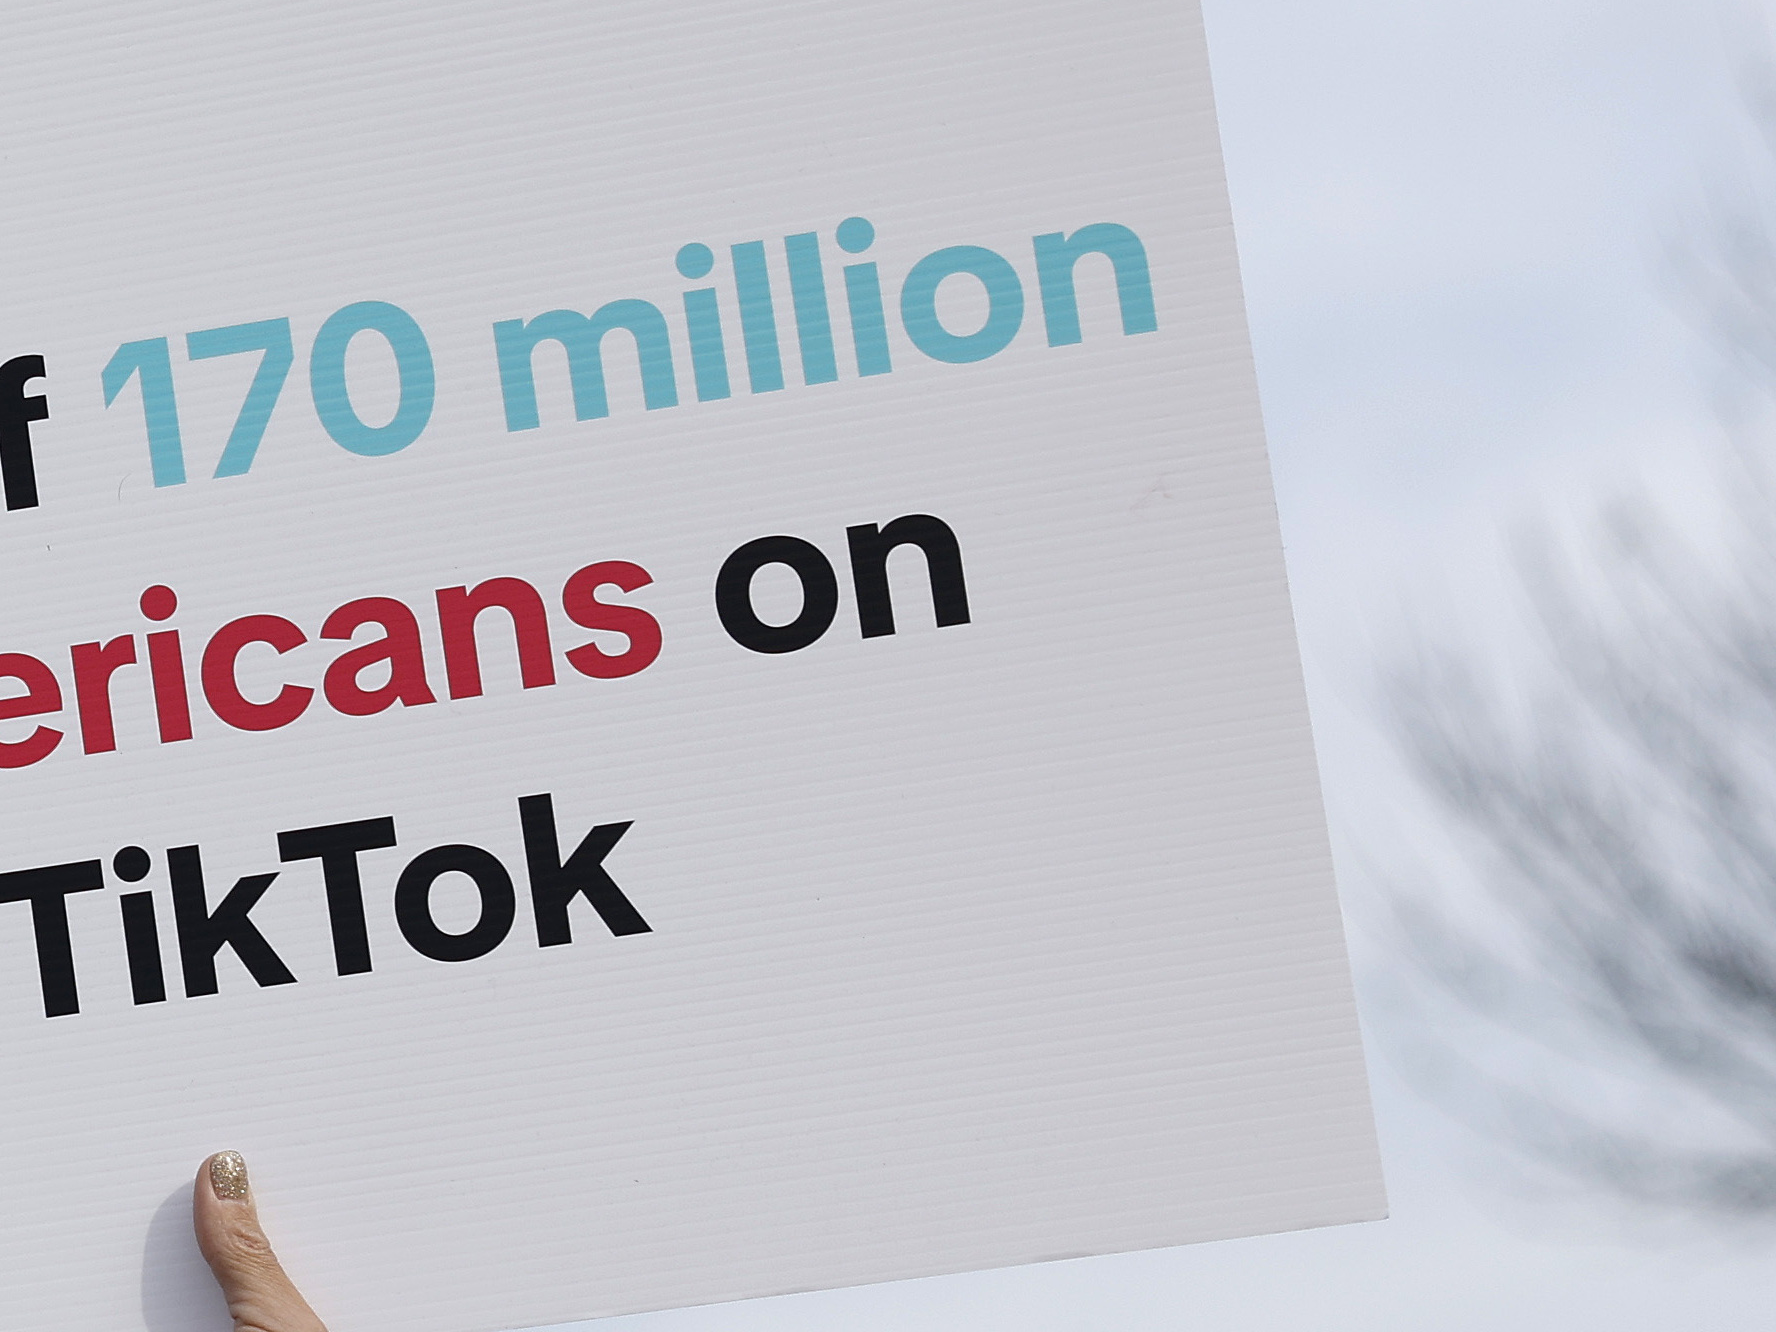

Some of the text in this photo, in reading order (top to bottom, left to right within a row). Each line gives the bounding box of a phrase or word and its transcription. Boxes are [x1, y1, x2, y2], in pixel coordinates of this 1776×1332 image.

[101, 301, 435, 487] 170
[493, 217, 1158, 432] million
[715, 514, 971, 654] on
